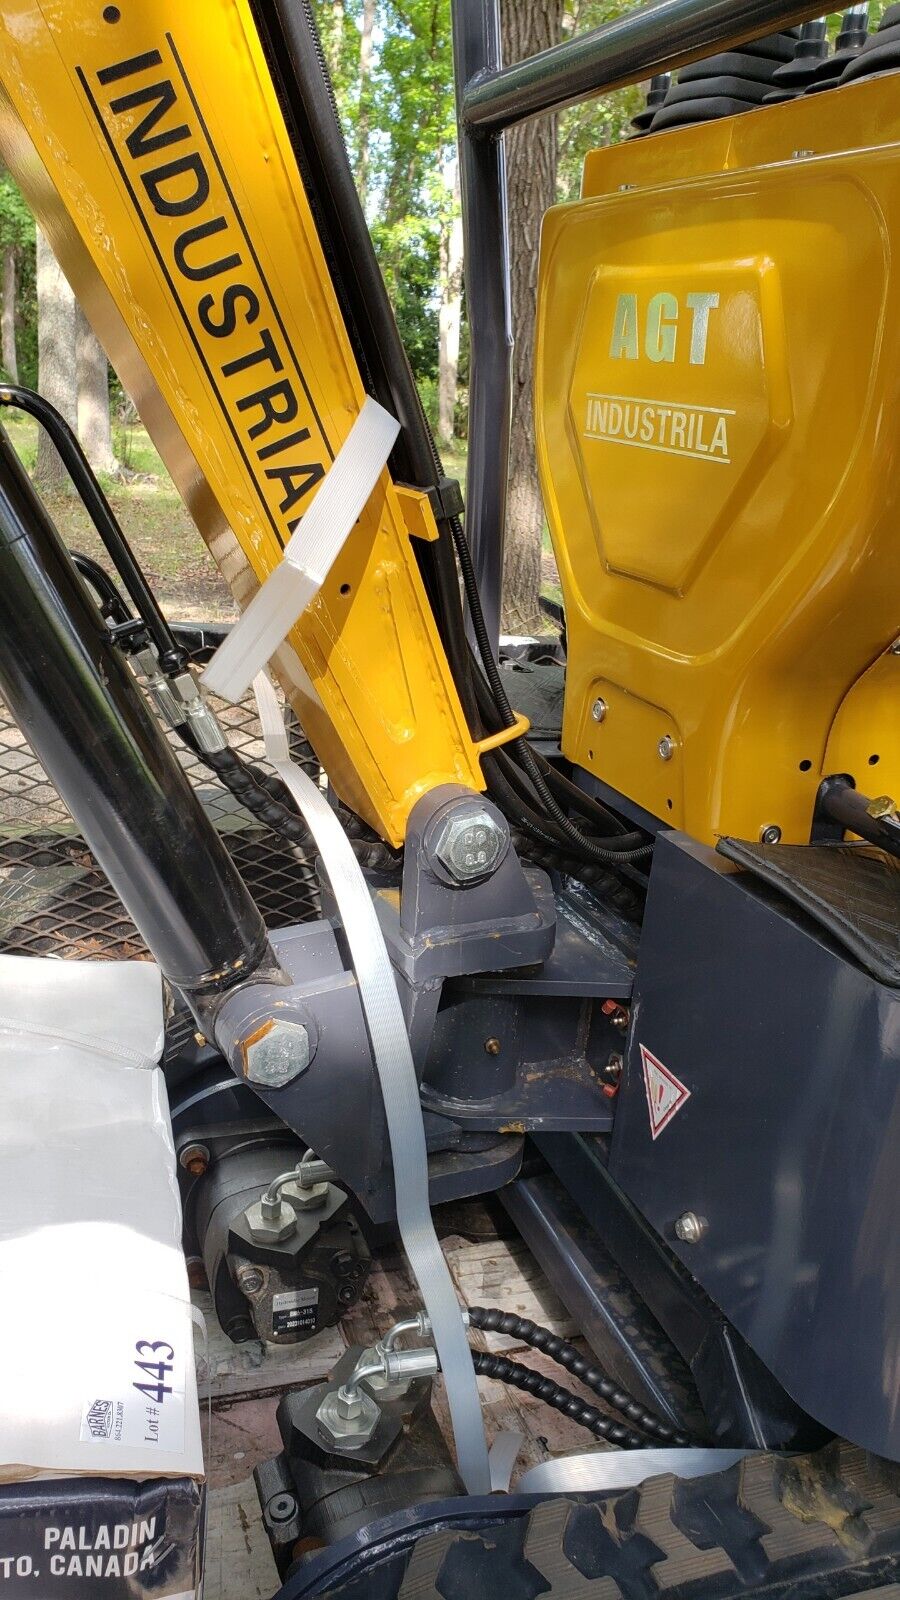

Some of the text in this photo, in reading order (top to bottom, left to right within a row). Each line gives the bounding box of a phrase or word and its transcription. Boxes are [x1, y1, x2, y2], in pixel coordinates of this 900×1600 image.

[97, 49, 359, 534] INDUSTRIA
[609, 292, 719, 365] AGT
[586, 399, 729, 456] INDUSTRILA
[132, 1340, 175, 1404] 443
[88, 1400, 110, 1437] BARNES
[144, 1416, 159, 1443] Lot
[44, 1517, 157, 1550] PALADIN
[0, 1545, 157, 1578] TO, CANADA
